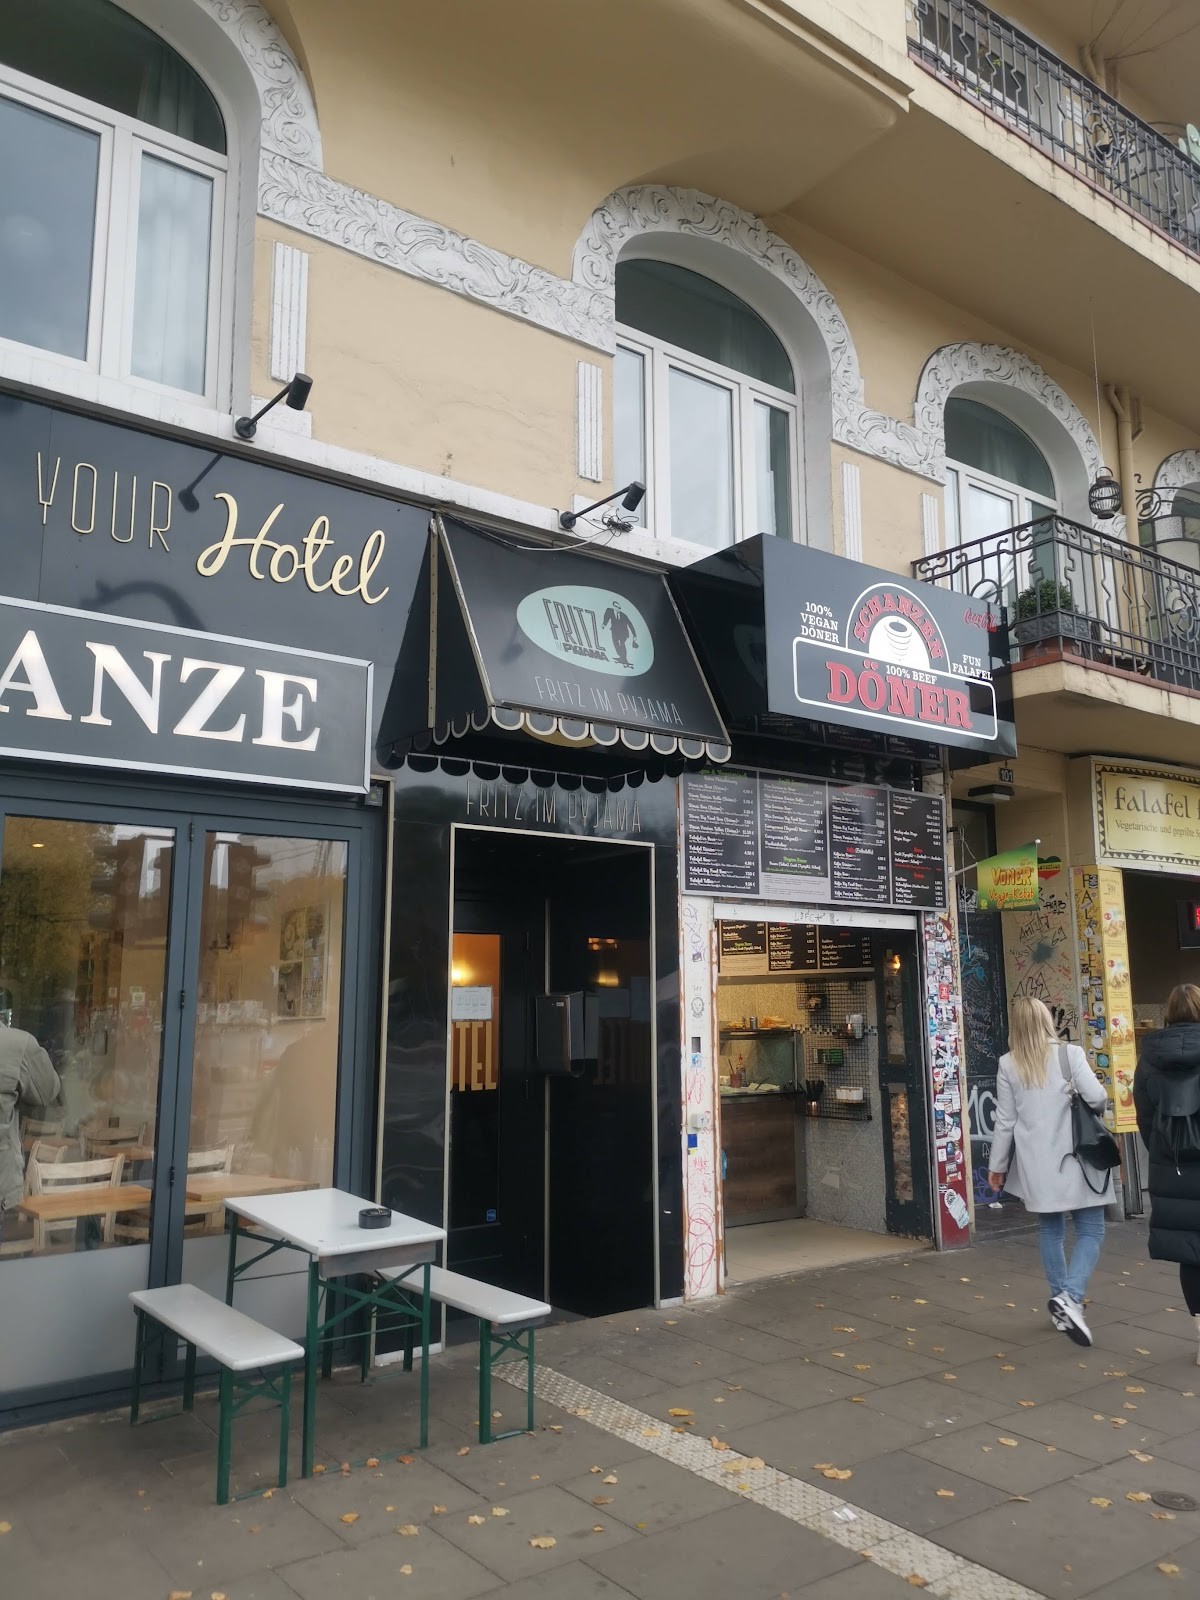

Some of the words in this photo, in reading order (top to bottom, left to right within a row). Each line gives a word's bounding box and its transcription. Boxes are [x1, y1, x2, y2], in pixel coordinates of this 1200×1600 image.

[37, 451, 173, 552] YOUR
[196, 492, 390, 605] Hotel
[541, 598, 607, 652] FRITZ
[801, 612, 838, 631] VEGAN
[805, 601, 833, 617] 100%
[853, 593, 943, 659] SCHANZEN
[801, 625, 839, 644] DÖNER
[885, 665, 911, 680] 100%
[912, 670, 938, 685] BEEF
[952, 662, 993, 681] FALAFEL
[962, 654, 982, 668] FUN
[0, 630, 321, 752] ANZE
[535, 676, 586, 708] FRITZ
[590, 687, 613, 713] IM
[616, 692, 684, 726] PYJAMA
[825, 659, 973, 729] DÖNER
[1000, 769, 1013, 783] 101
[466, 781, 523, 821] FRITZ
[536, 788, 556, 825] IM
[568, 792, 642, 833] PYJAMA
[1115, 819, 1158, 832] Vegetarische
[1160, 824, 1171, 834] und
[450, 1020, 497, 1092] TEL
